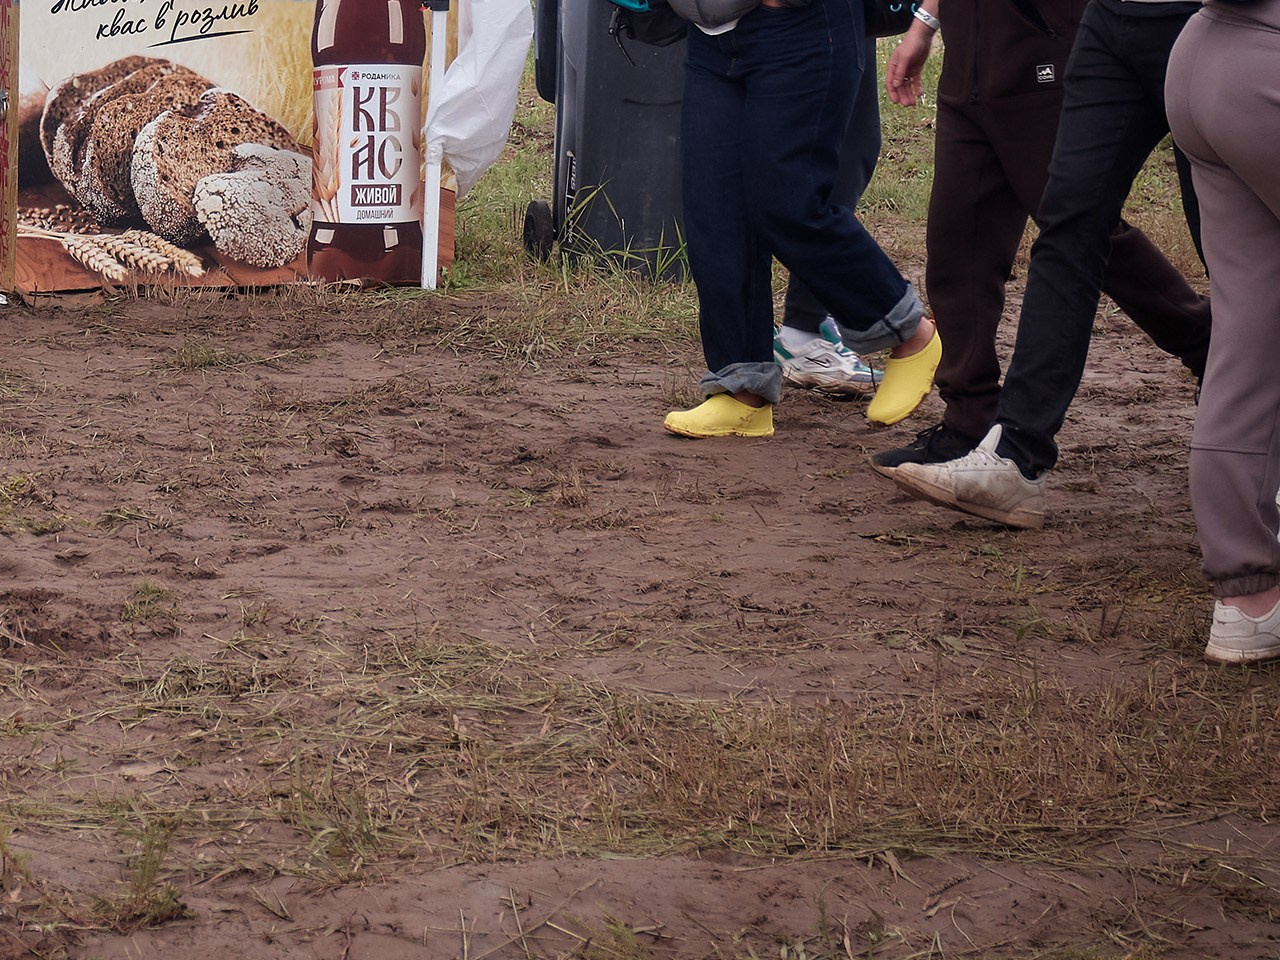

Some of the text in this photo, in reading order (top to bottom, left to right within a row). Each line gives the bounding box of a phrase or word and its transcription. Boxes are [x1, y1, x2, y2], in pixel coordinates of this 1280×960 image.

[96, 7, 148, 40] квас
[155, 0, 166, 30] в
[362, 72, 401, 81] РОДАНИКА
[355, 184, 397, 205] ЖИВОЙ
[356, 208, 394, 220] ДОМАШНИЙ
